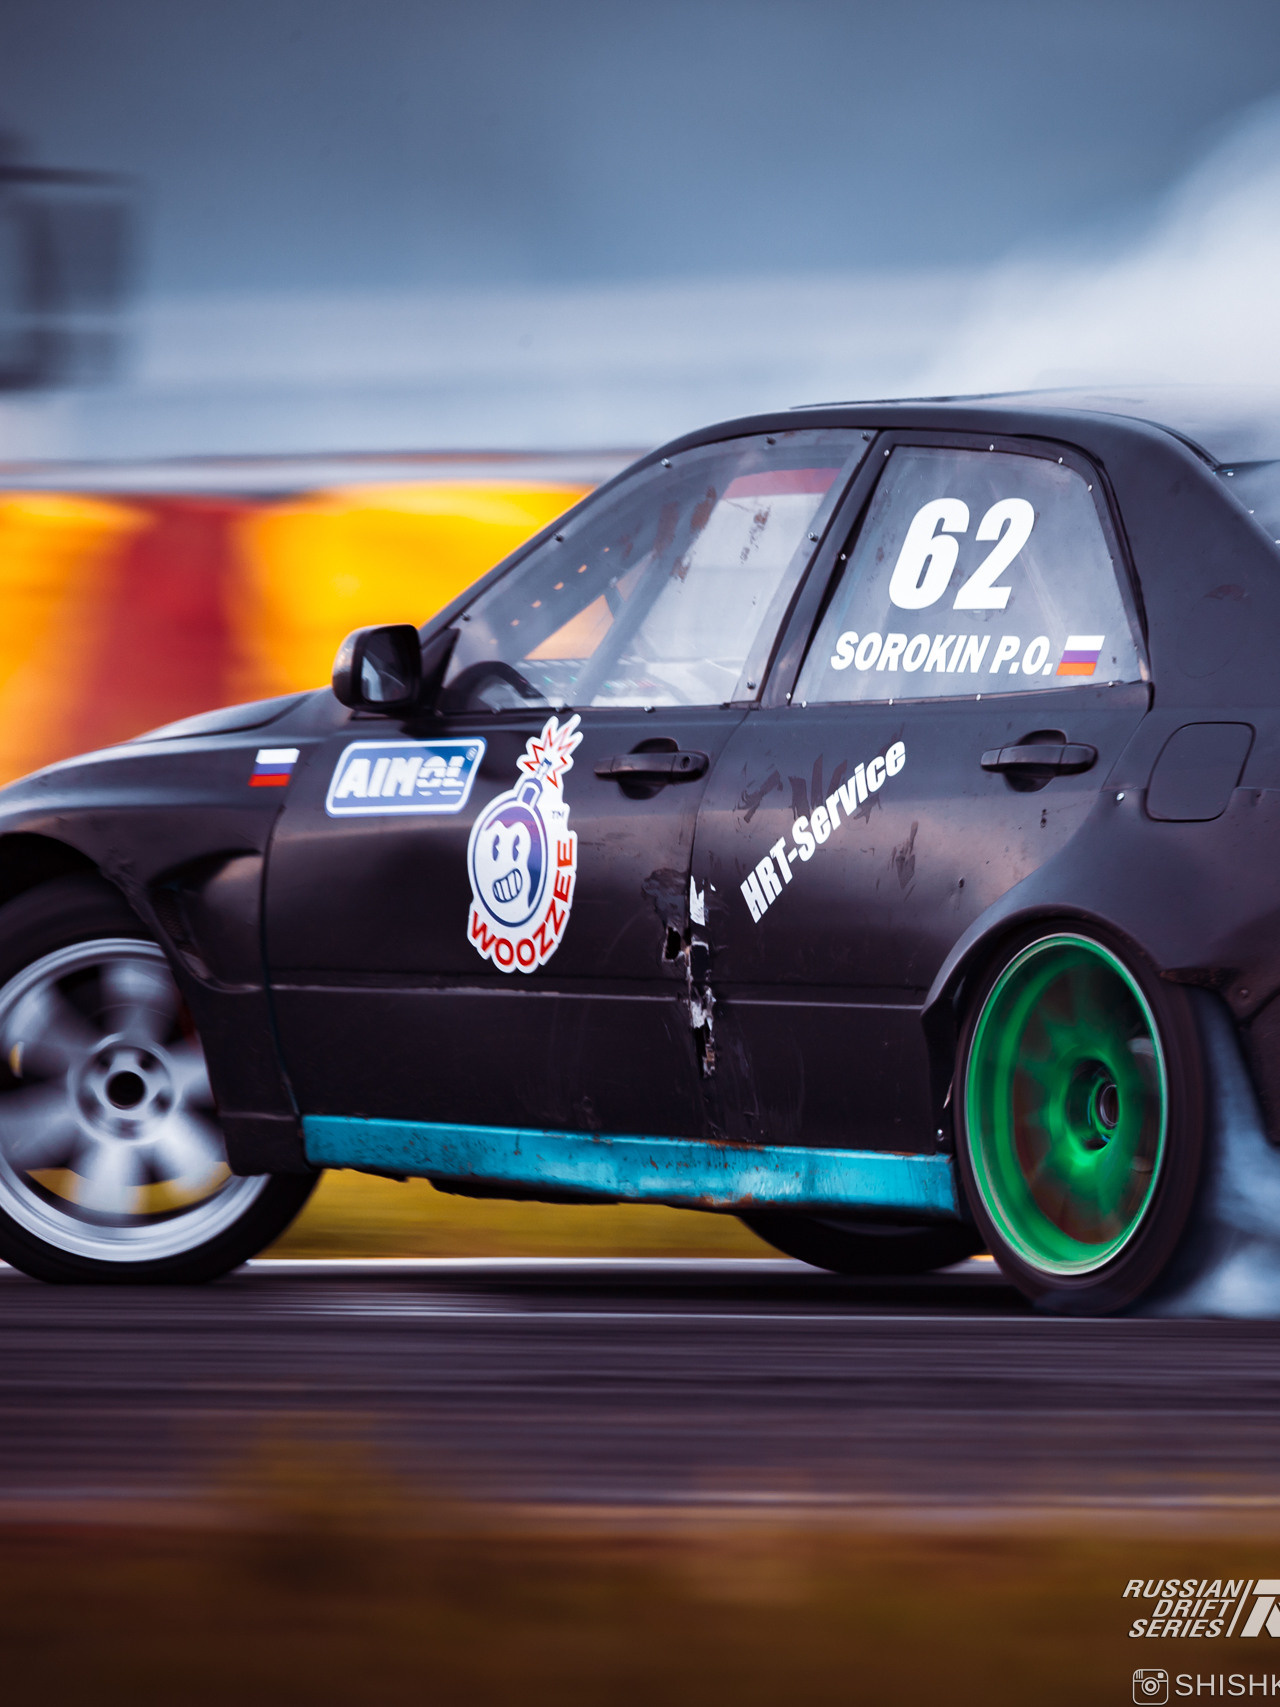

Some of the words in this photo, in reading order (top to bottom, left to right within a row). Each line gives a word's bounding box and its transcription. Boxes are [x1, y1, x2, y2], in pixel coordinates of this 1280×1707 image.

[888, 497, 1035, 610] 62
[830, 631, 991, 673] SOROKIN
[989, 635, 1053, 676] P.O.
[334, 755, 465, 799] AIMOL
[740, 741, 906, 924] HRT-Service
[472, 838, 573, 966] WOOZZEE
